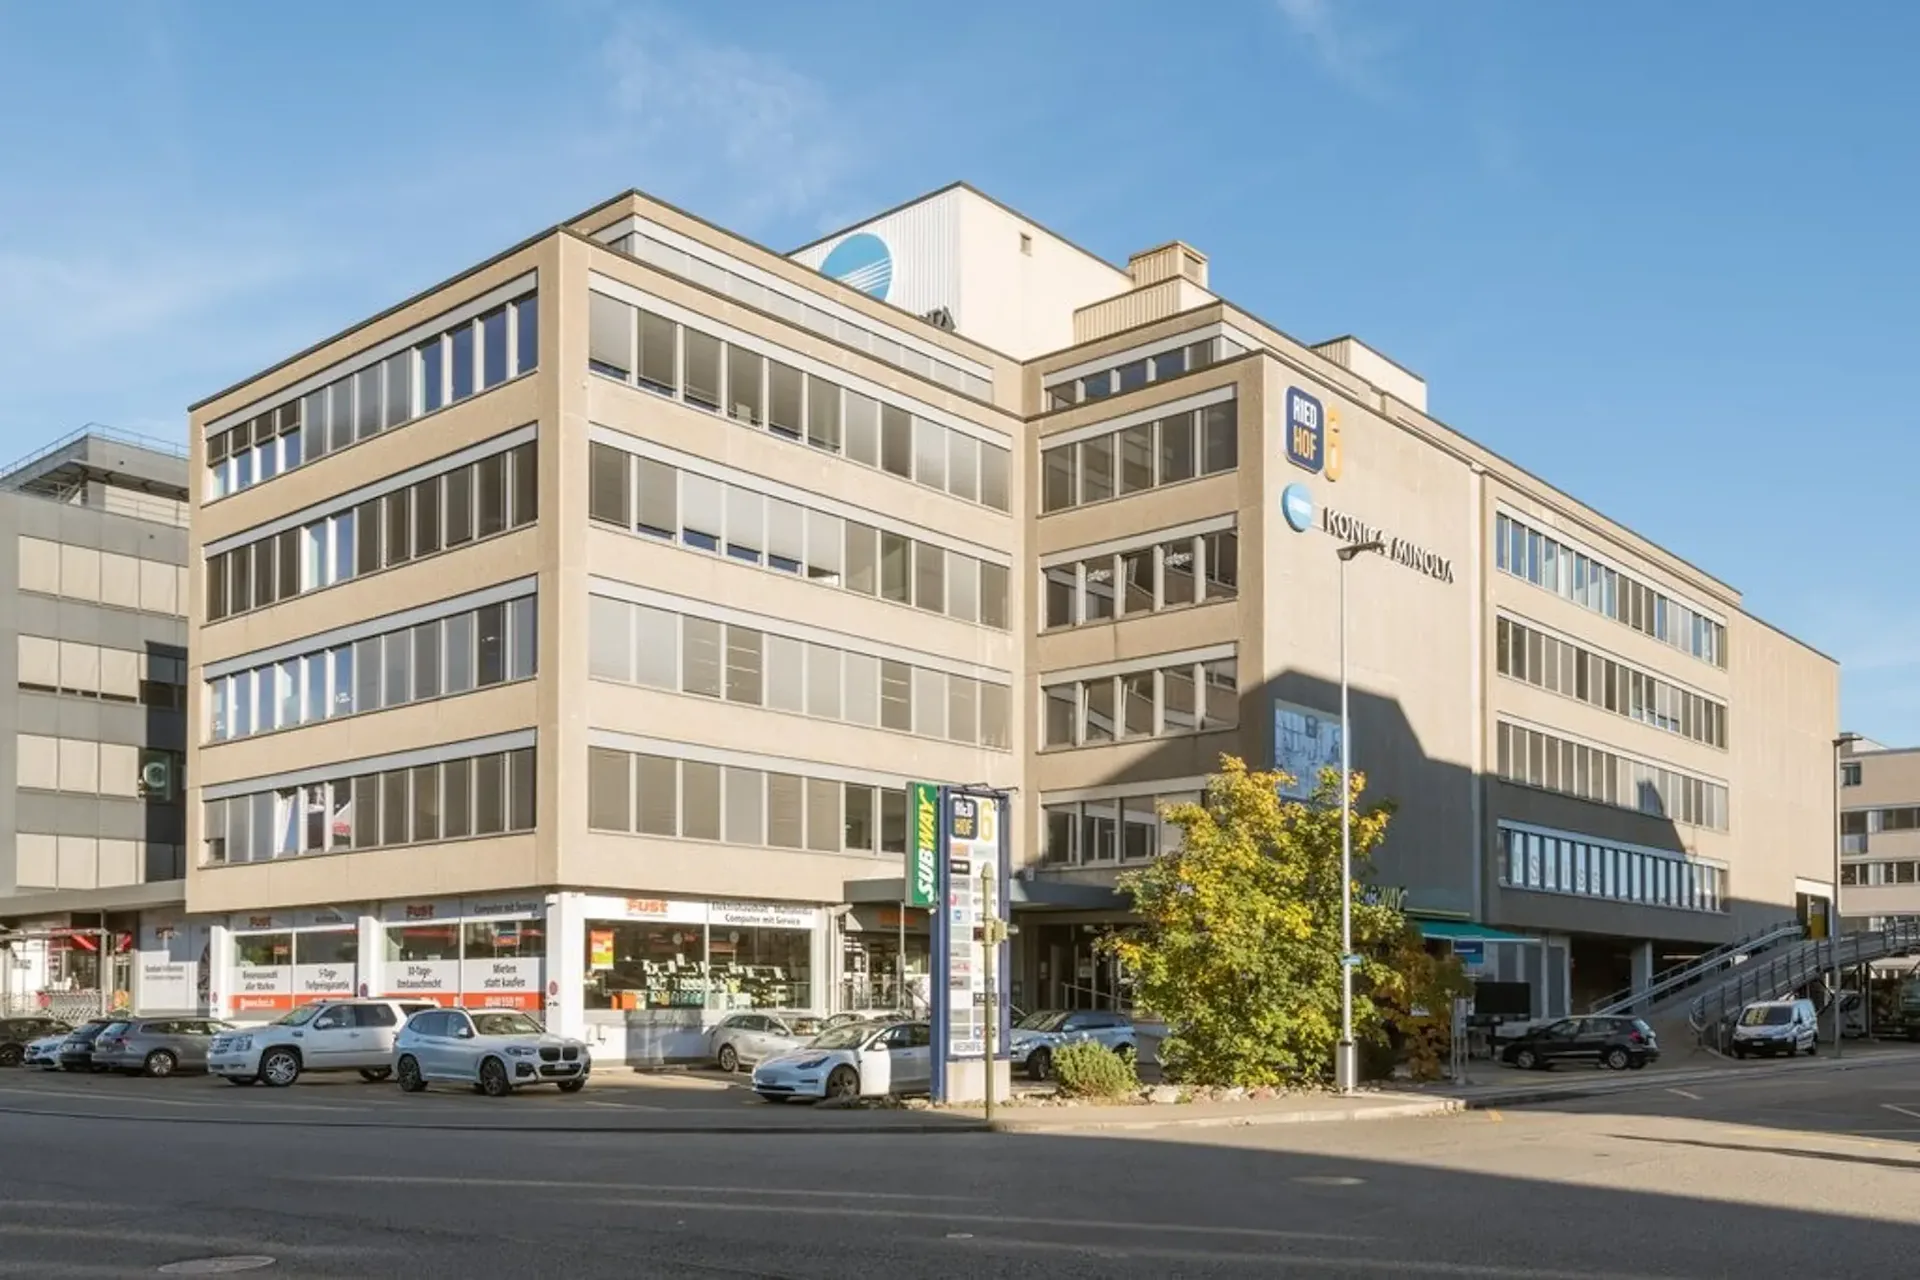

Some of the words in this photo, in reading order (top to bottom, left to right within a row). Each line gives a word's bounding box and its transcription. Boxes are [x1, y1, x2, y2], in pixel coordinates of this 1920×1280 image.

[1293, 395, 1317, 429] RIED
[1293, 425, 1317, 460] HOF
[1390, 536, 1455, 584] MINOLTA
[918, 785, 936, 904] SUBWAY
[725, 914, 761, 926] Computer
[762, 916, 774, 925] mit
[775, 916, 801, 927] Service
[484, 977, 501, 988] statt
[502, 976, 525, 988] kaufen
[493, 963, 517, 975] Mieten
